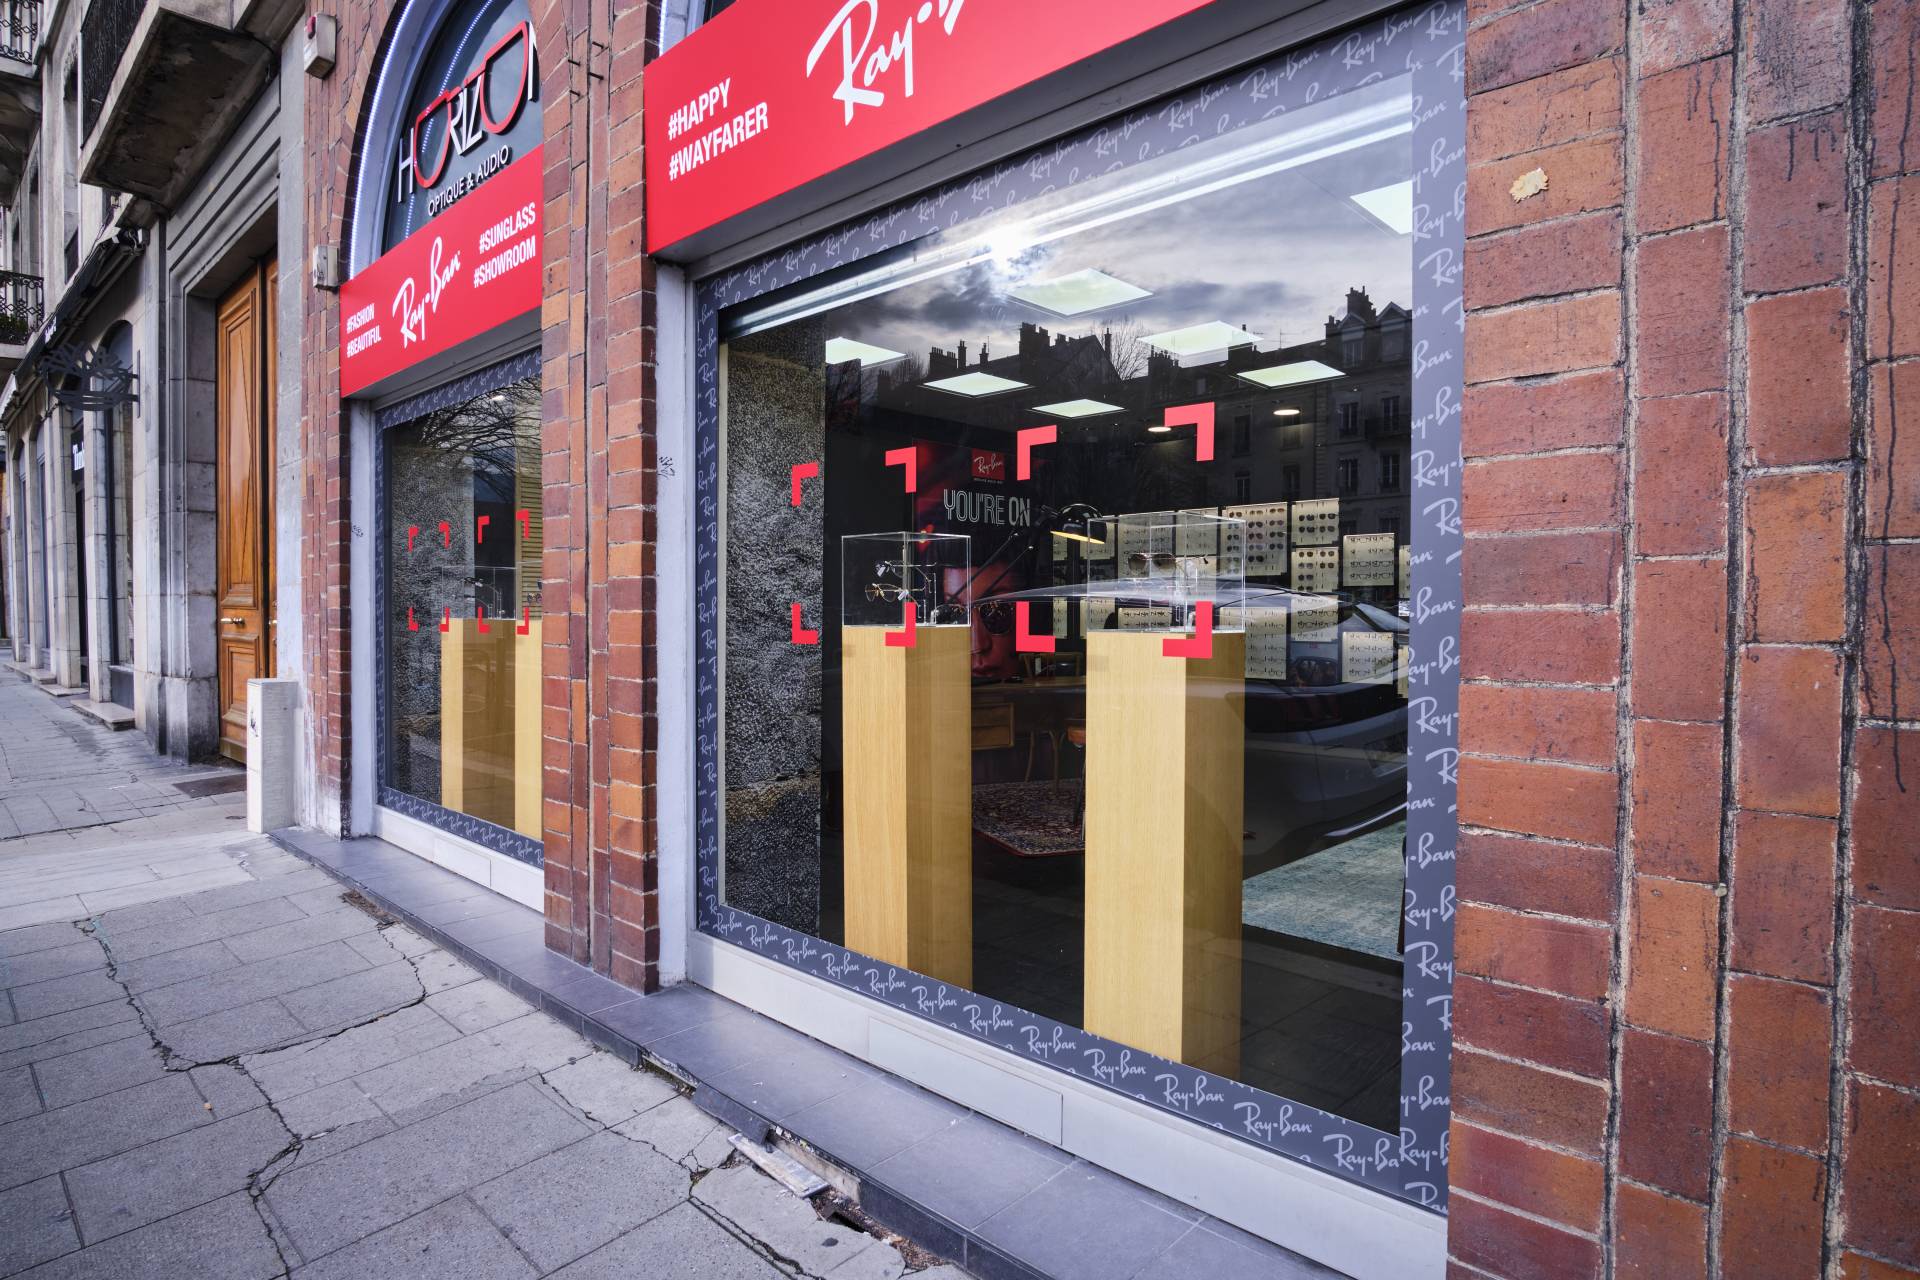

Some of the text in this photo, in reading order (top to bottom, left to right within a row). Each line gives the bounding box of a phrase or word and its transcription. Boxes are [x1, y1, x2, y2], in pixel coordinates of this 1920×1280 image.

[806, 0, 964, 126] Ray-
[668, 77, 731, 141] #HAPPY
[669, 101, 769, 181] #WAYFARER
[428, 144, 509, 217] OPTIQUE & AUDIO
[479, 202, 536, 254] #SUNGLASS
[473, 235, 536, 288] #SHOWROOM
[346, 302, 375, 334] #FASHION
[346, 324, 381, 358] #BEAUTIFUL
[943, 489, 1030, 527] YOU'RE ON
